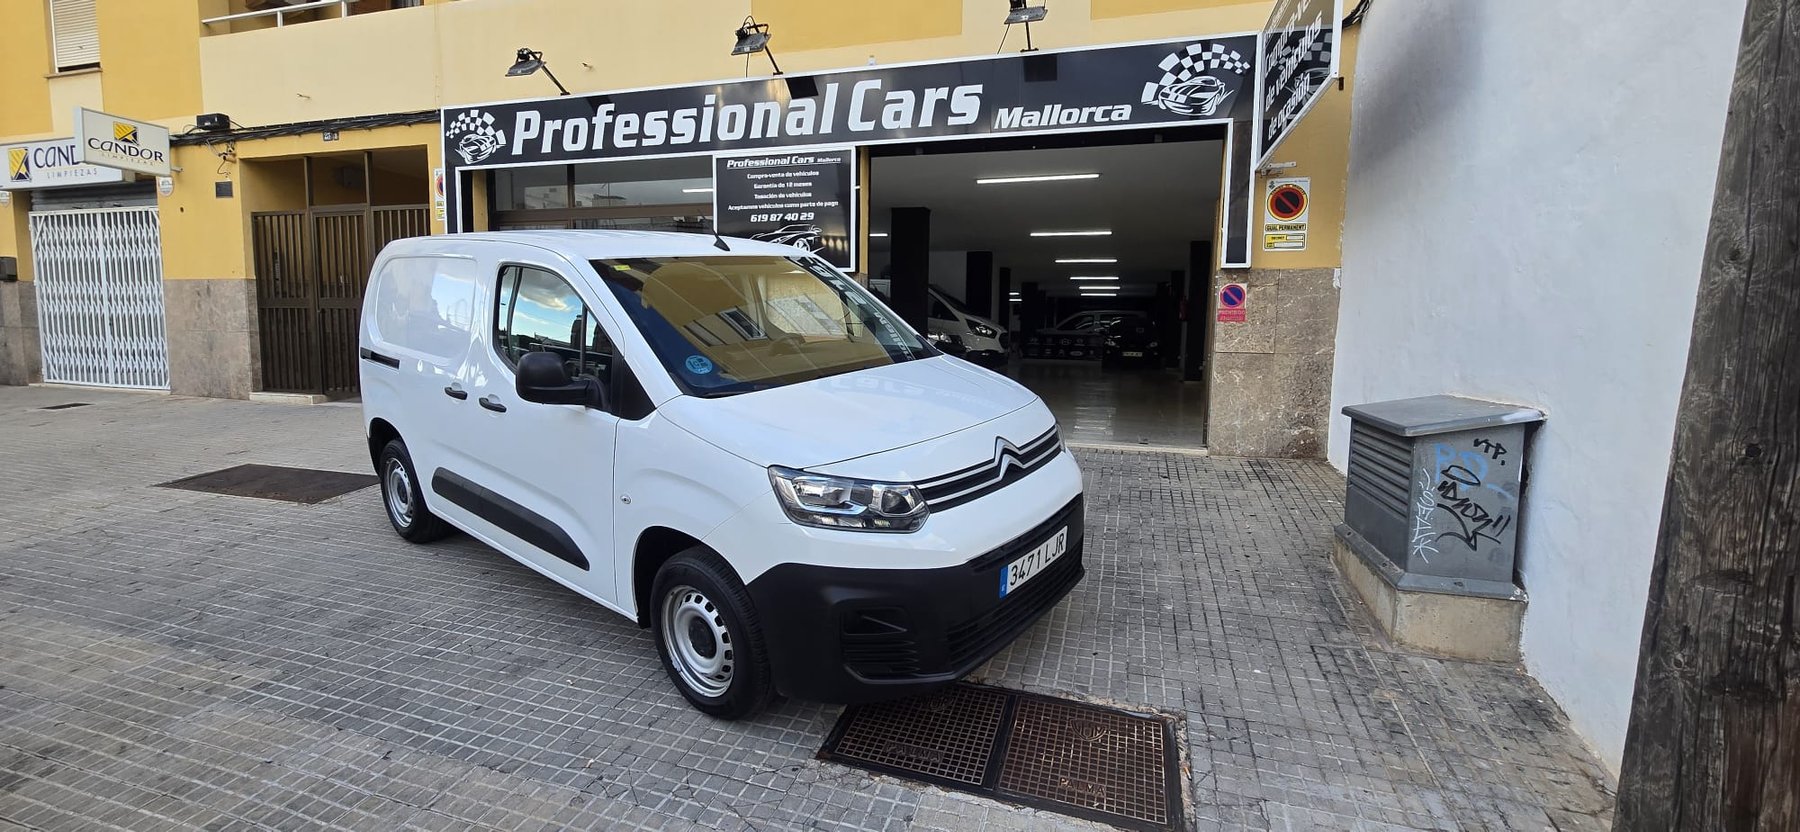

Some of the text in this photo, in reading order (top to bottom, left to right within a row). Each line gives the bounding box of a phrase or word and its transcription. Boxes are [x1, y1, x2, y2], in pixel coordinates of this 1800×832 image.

[511, 78, 1132, 156] Professional Cars Mallorca
[727, 156, 790, 168] Professional
[791, 155, 815, 165] Cars
[47, 168, 98, 179] LIMPIEZAS
[750, 212, 815, 223] 619 87 40 29
[1009, 533, 1065, 587] 3471 LJR
[1058, 777, 1106, 797] PALMA
